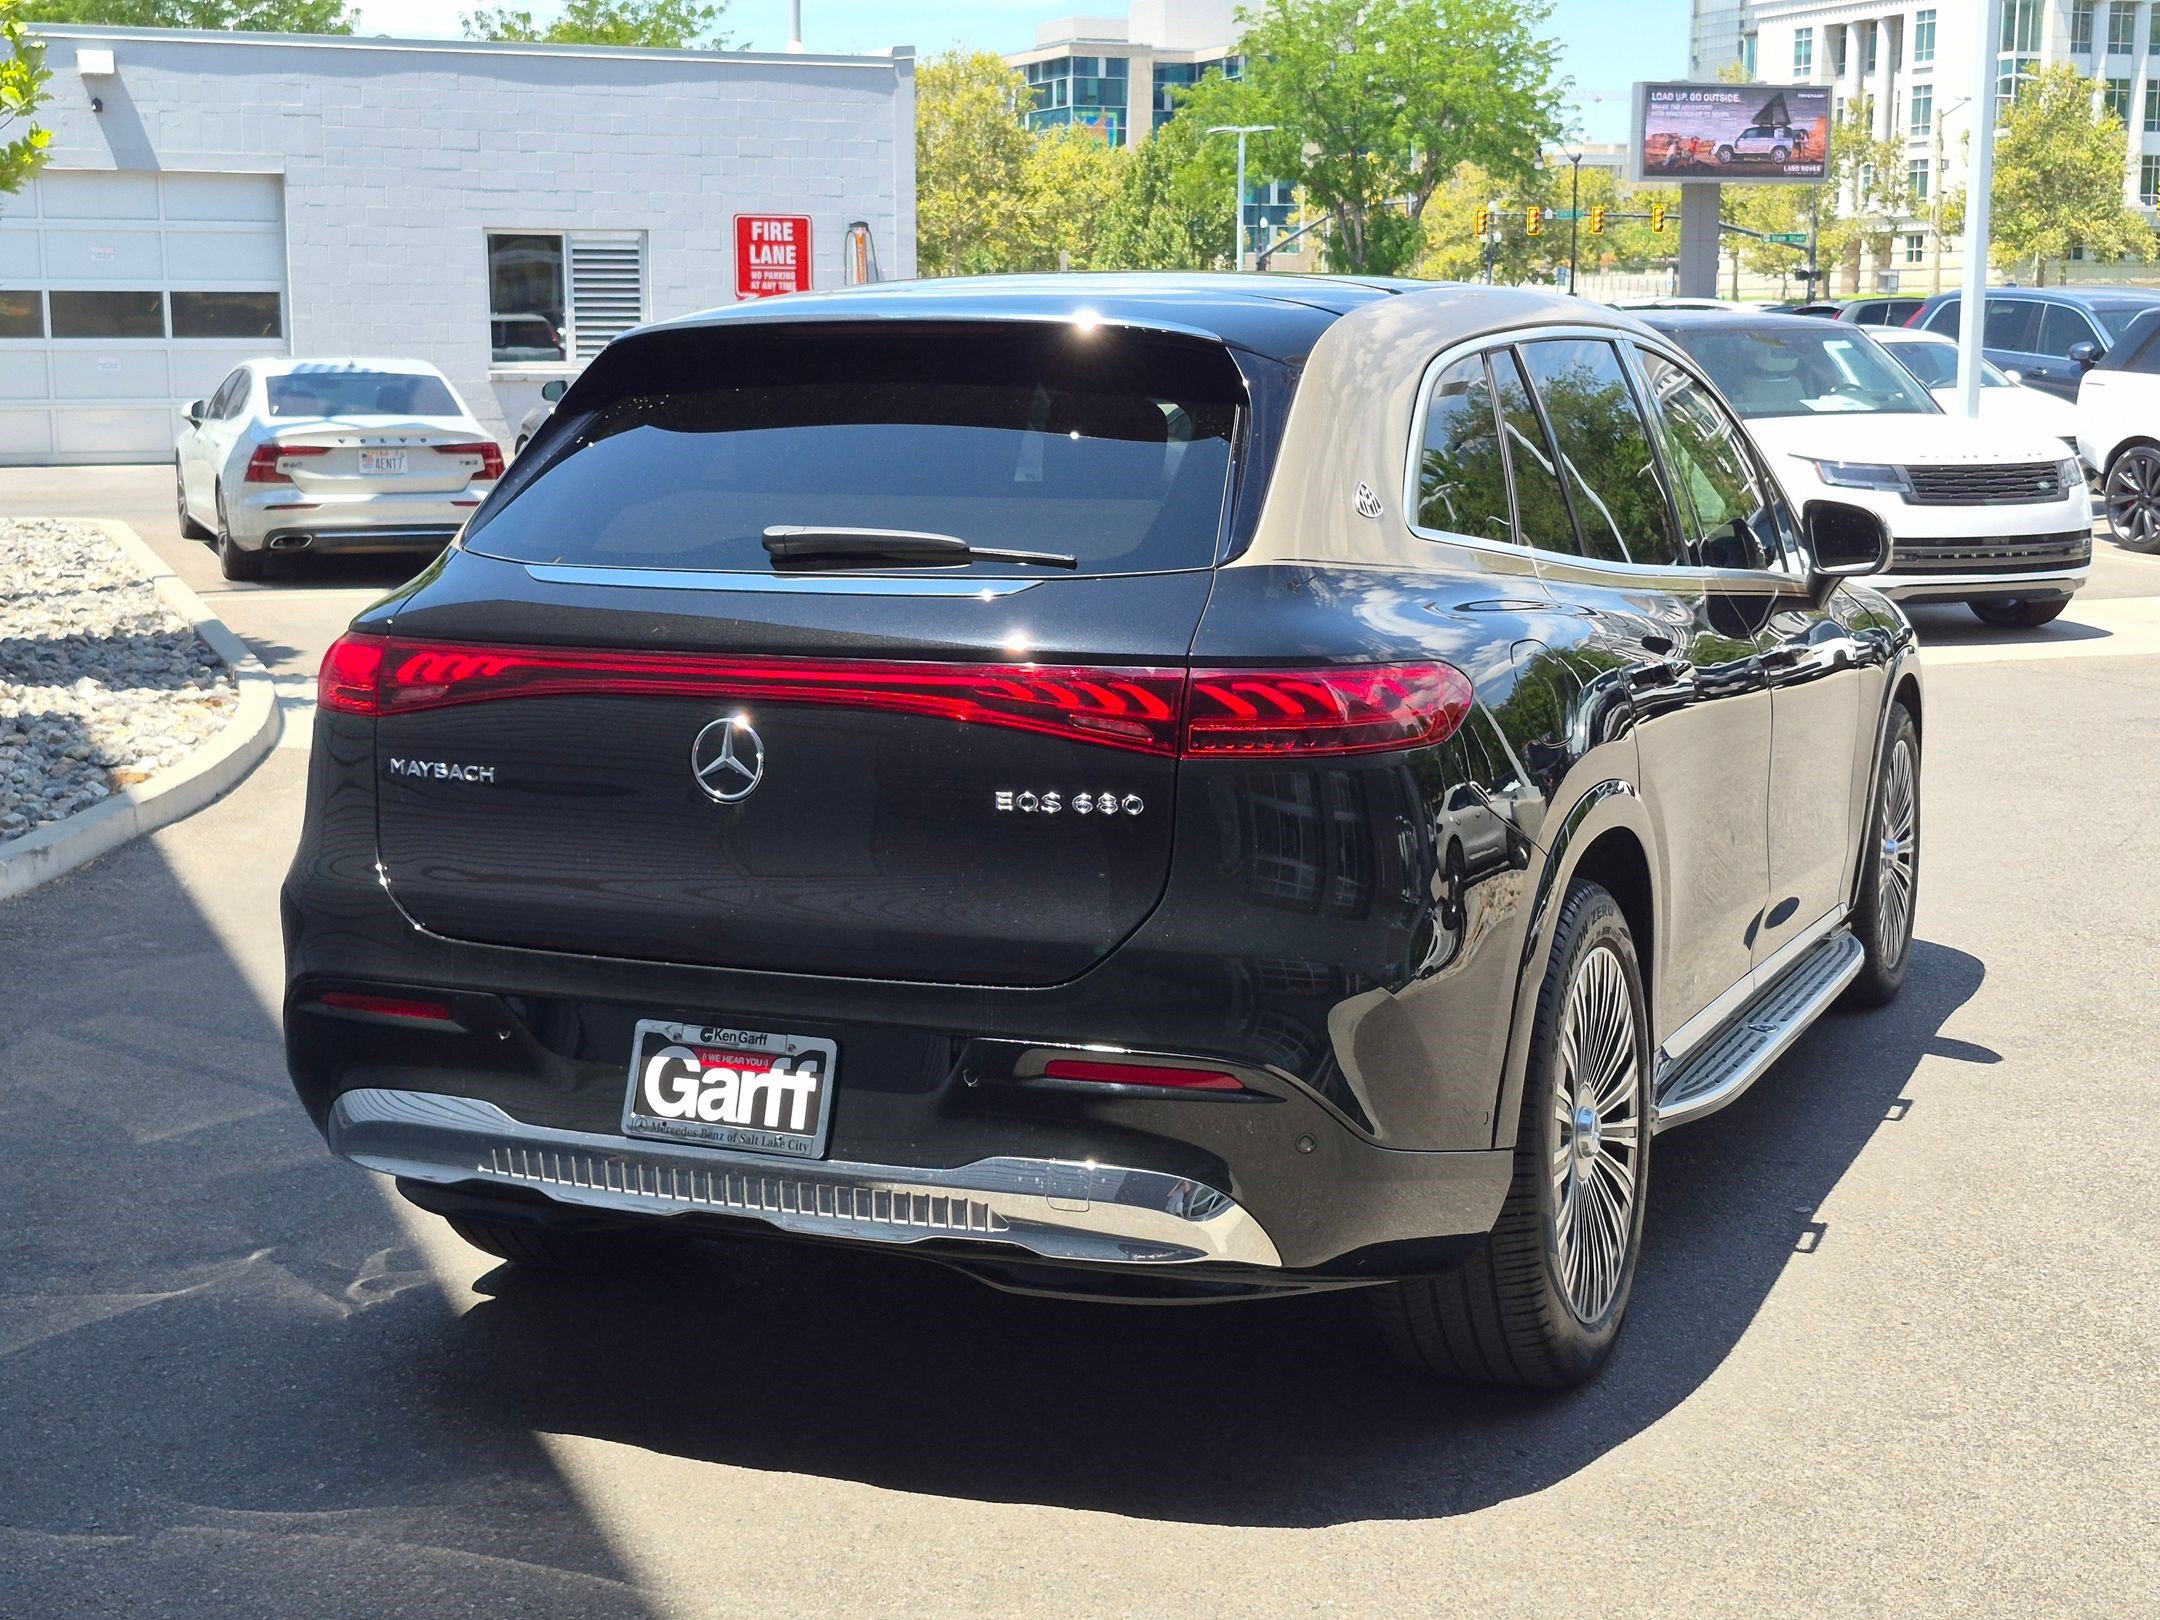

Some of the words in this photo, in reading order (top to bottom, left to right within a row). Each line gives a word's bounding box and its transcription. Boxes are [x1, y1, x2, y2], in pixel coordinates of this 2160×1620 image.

[1651, 92, 1674, 101] LOAD
[1689, 92, 1702, 101] GO
[751, 221, 794, 242] FIRE
[749, 244, 797, 265] LANE
[750, 281, 761, 290] AT
[761, 281, 777, 291] ANY
[778, 281, 797, 292] TIME
[751, 271, 762, 280] NO
[763, 271, 796, 281] PARKING
[390, 757, 495, 783] MAYBACH
[995, 790, 1062, 813] EQS
[1071, 792, 1145, 816] 680
[1590, 904, 1614, 926] ZERO
[714, 1027, 737, 1043] Ken
[738, 1031, 768, 1046] Garff
[708, 1053, 721, 1064] WE
[722, 1055, 745, 1066] HEAR
[745, 1057, 763, 1068] YOU
[644, 1045, 818, 1131] Garff
[727, 1131, 737, 1143] of
[740, 1133, 758, 1146] Salt
[761, 1135, 786, 1148] Lake
[788, 1138, 810, 1152] City
